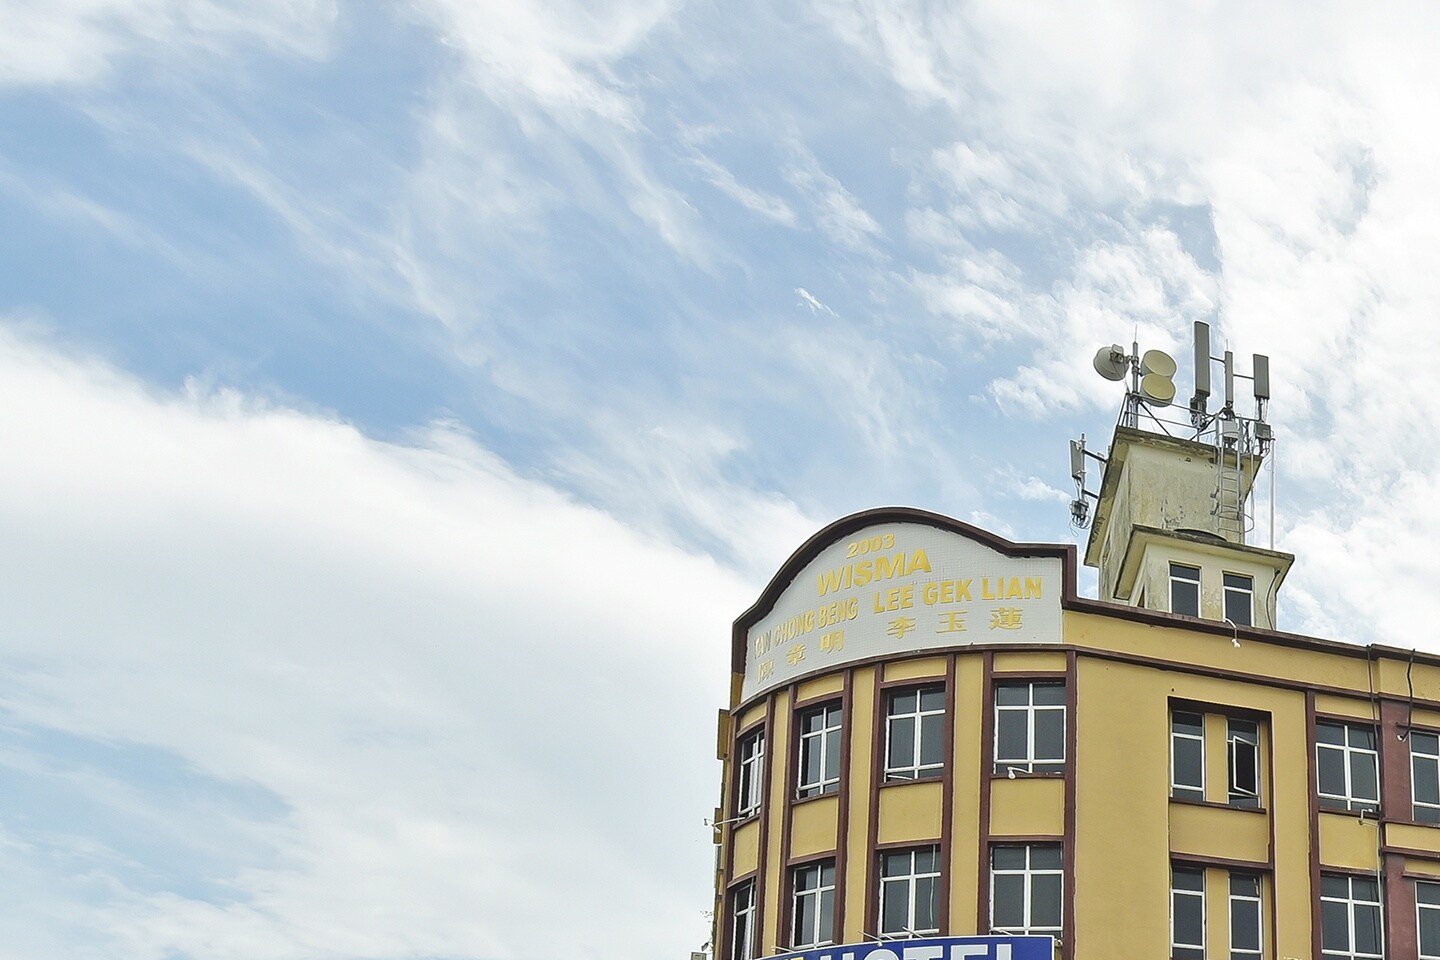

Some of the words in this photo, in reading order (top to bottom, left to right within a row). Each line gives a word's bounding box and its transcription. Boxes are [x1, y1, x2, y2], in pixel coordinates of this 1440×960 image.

[846, 532, 896, 559] 2003
[816, 548, 932, 597] WISMA
[753, 630, 772, 660] TAN
[772, 609, 815, 648] CHONG
[817, 597, 859, 630] BENG
[873, 588, 914, 614] LEE
[922, 579, 972, 606] GEK
[981, 577, 1042, 601] LIAN
